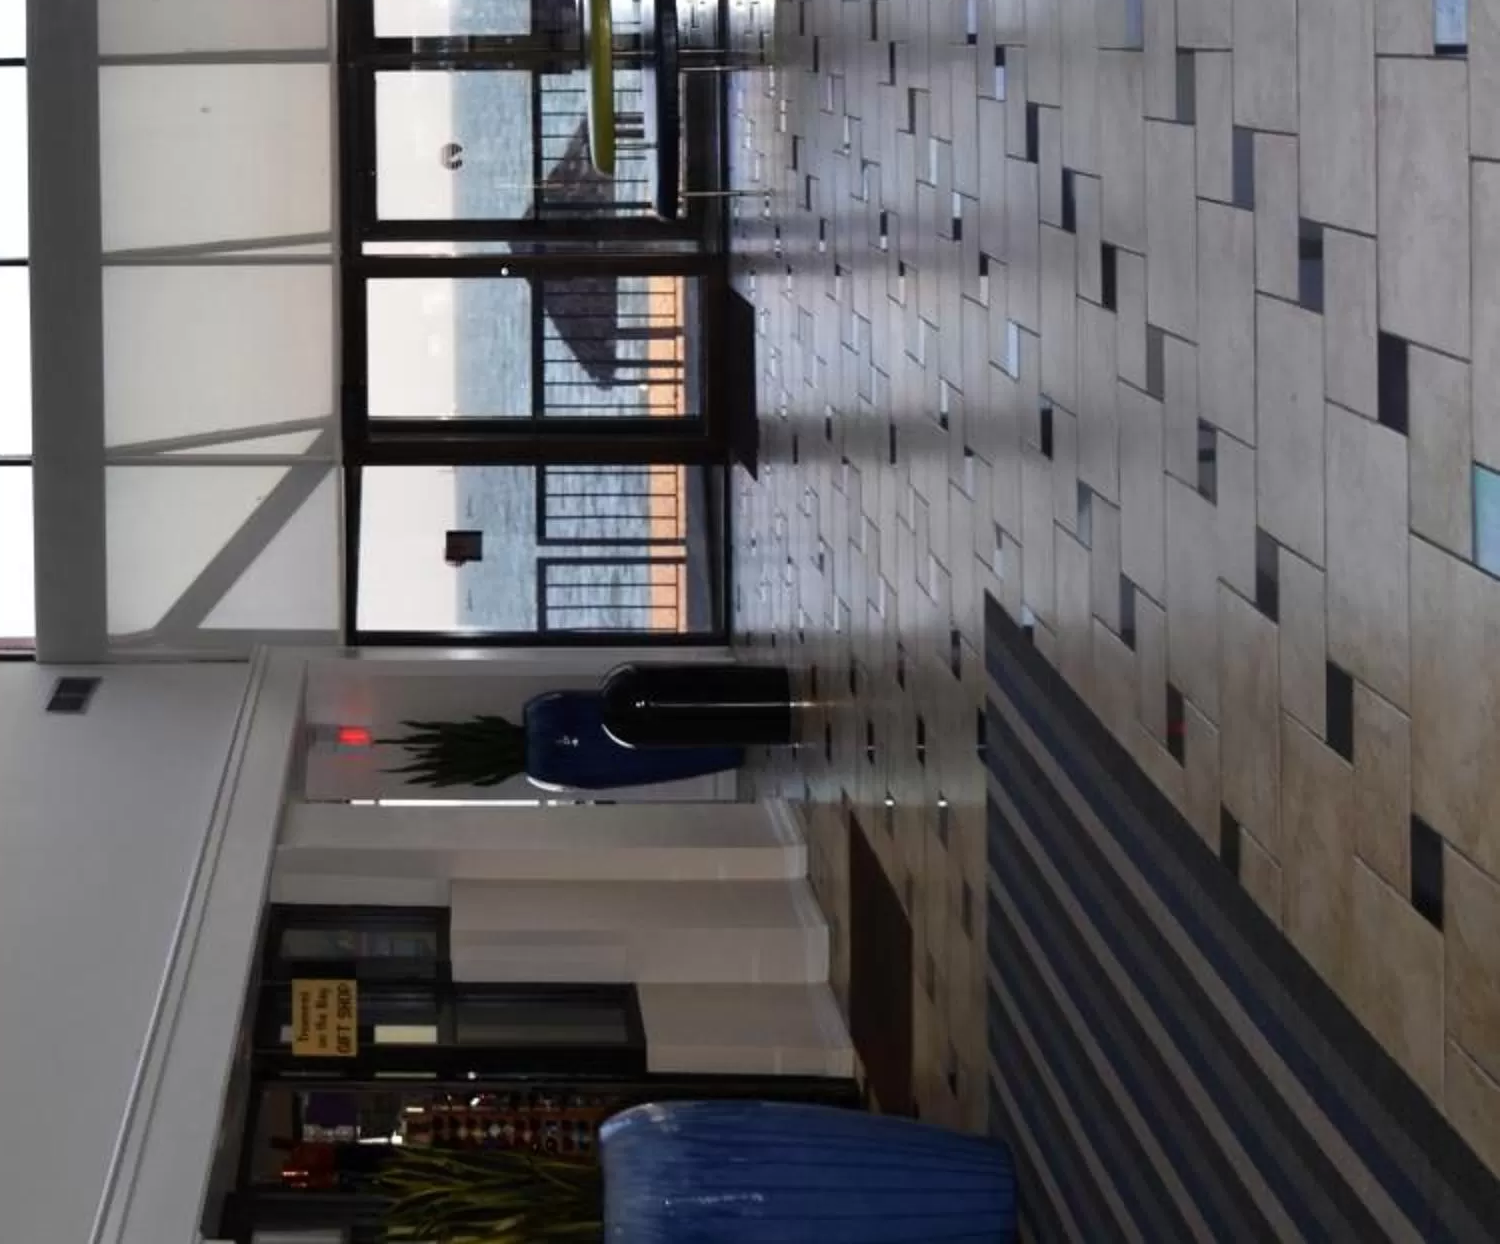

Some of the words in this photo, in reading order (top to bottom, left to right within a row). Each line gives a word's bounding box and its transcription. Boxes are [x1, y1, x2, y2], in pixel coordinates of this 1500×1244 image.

[337, 983, 352, 1019] SHOP
[314, 1014, 328, 1030] the
[337, 1025, 352, 1054] GIFT
